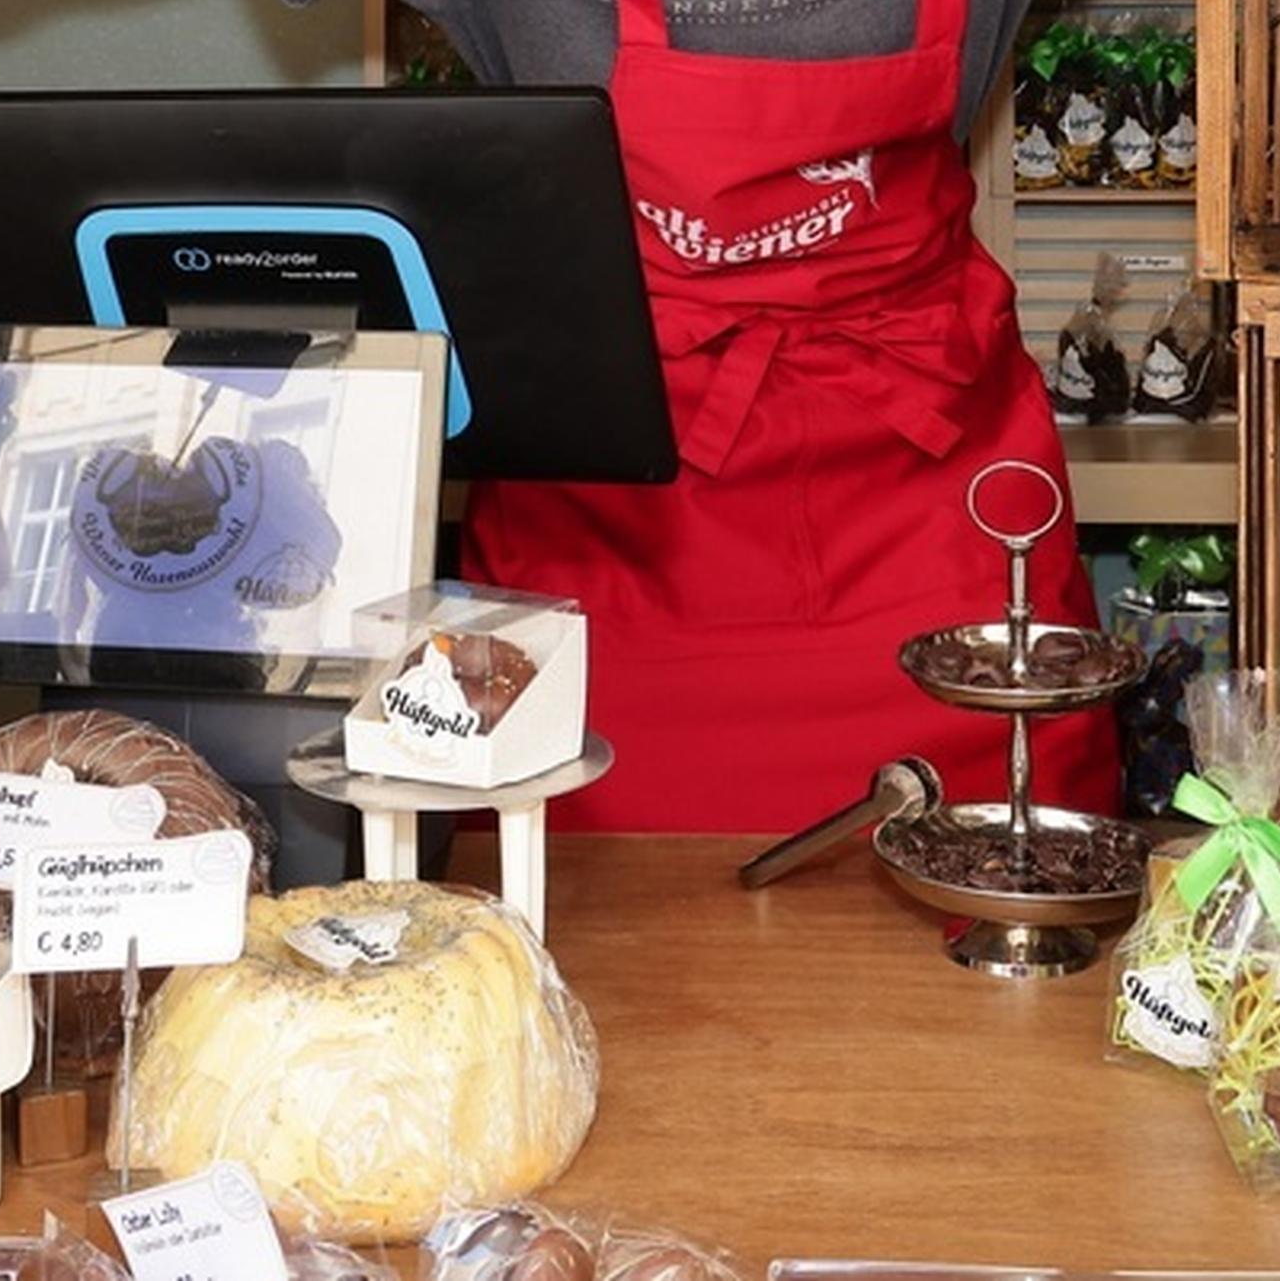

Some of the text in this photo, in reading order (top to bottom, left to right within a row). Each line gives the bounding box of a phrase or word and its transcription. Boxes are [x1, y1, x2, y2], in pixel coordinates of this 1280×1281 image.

[636, 200, 708, 242] alt
[656, 200, 855, 265] wiener
[385, 686, 475, 739] Hüftgold
[37, 930, 104, 957] € 4,80
